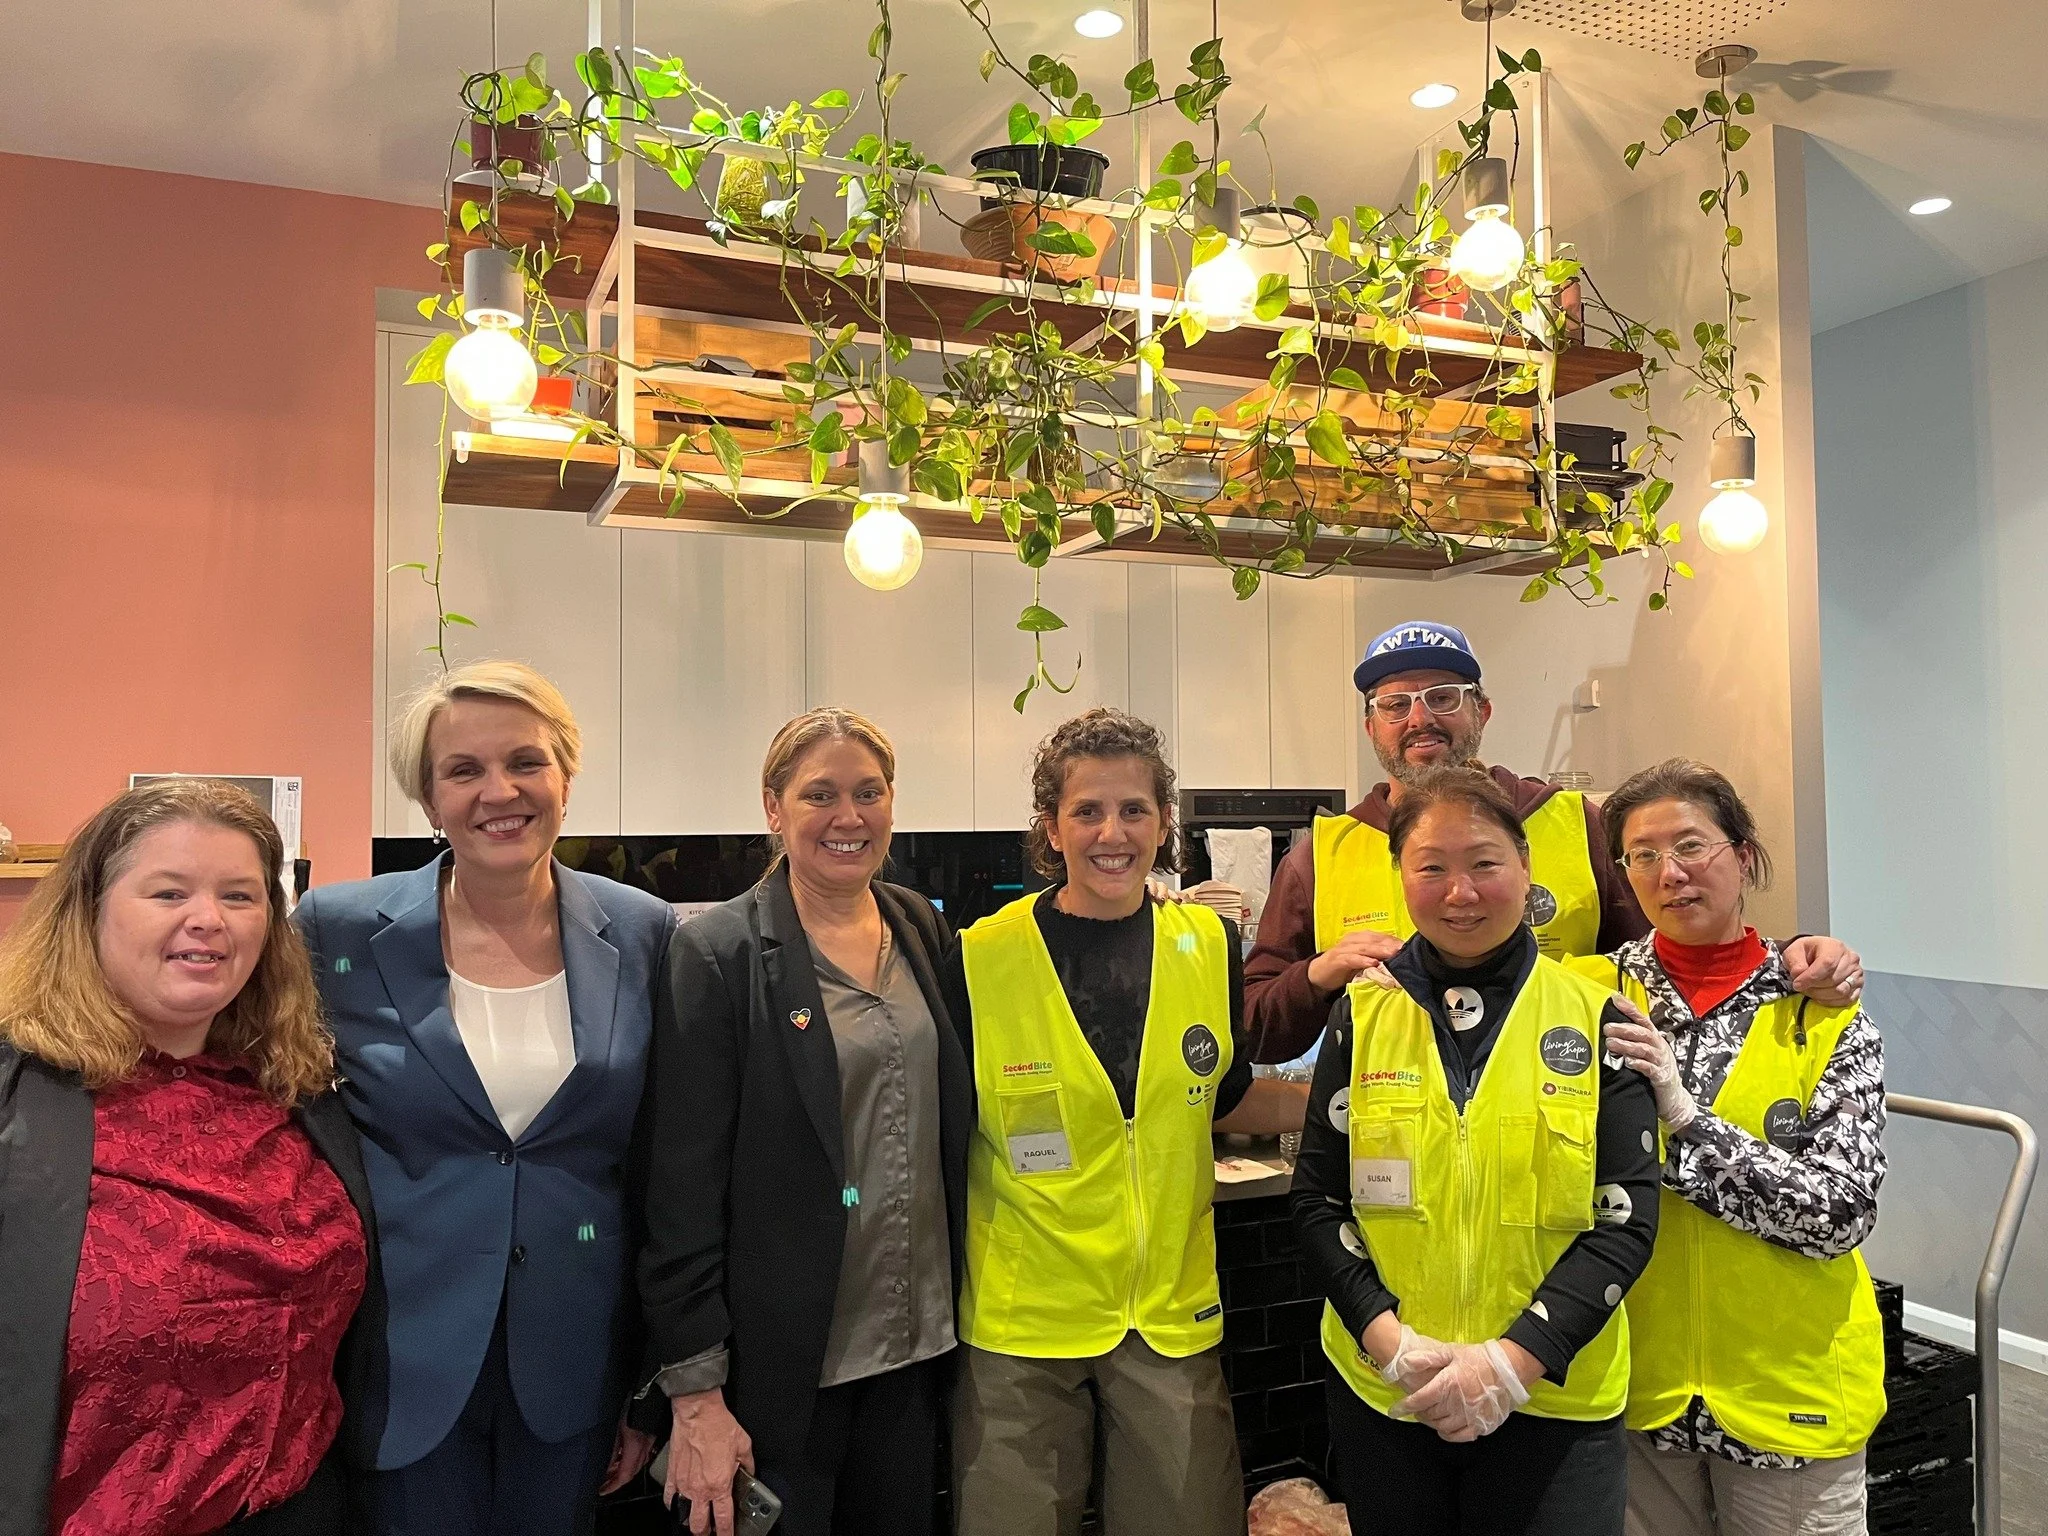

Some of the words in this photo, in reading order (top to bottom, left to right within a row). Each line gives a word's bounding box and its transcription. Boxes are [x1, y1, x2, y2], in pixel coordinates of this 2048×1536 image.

[1003, 1062, 1052, 1072] SecondBite
[1023, 1149, 1057, 1158] RAQUEL
[1367, 1174, 1392, 1183] SUSAN
